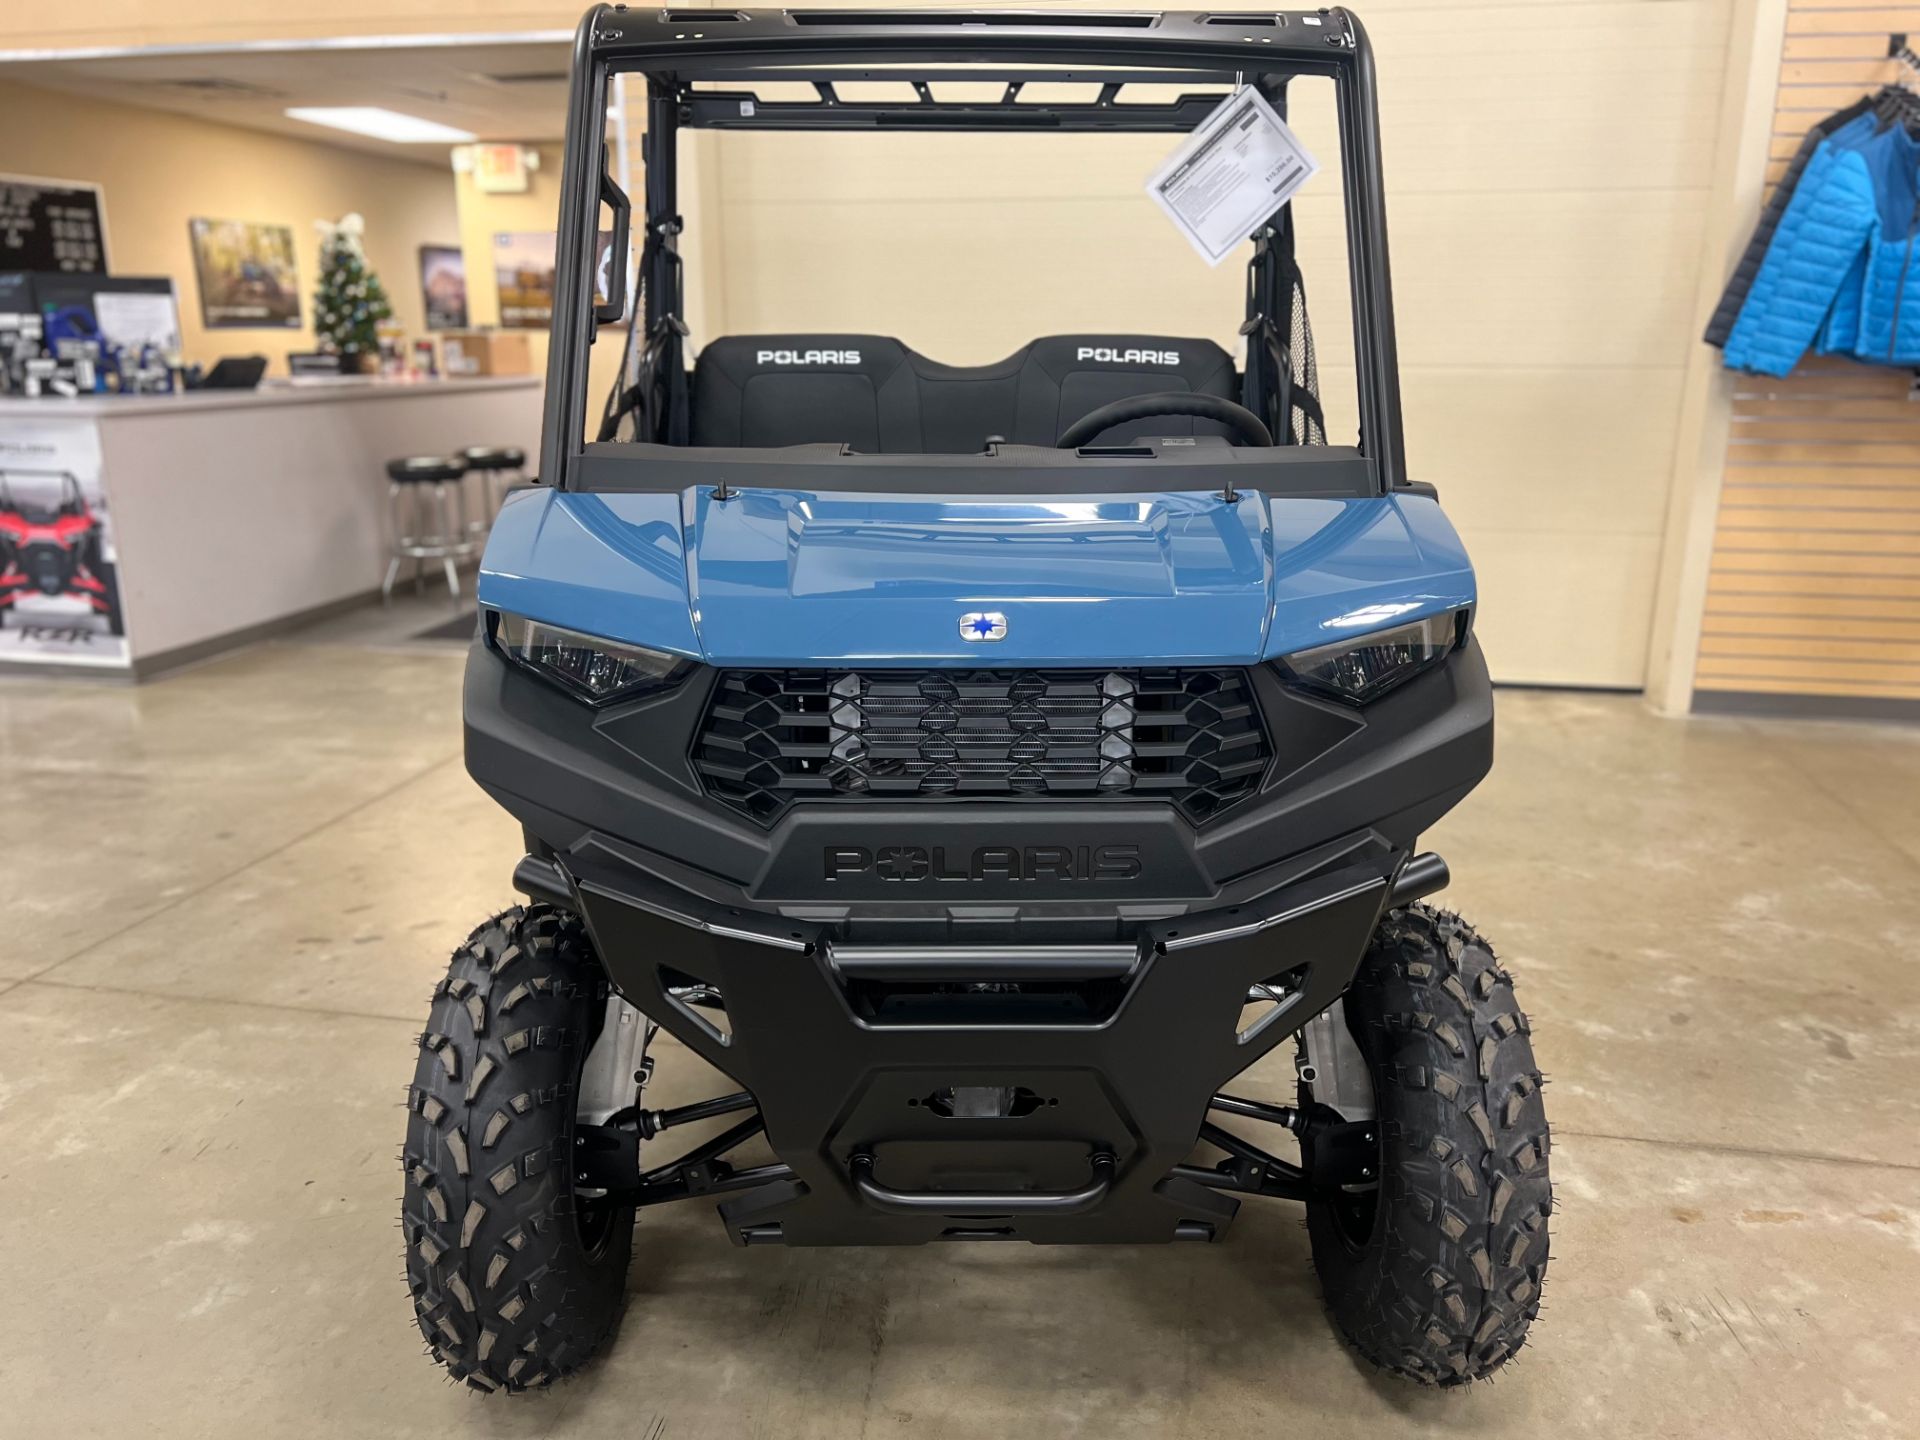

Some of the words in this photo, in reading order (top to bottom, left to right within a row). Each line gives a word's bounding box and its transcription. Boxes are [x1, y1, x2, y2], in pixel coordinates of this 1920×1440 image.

[757, 350, 861, 364] POLARIS
[1077, 347, 1180, 365] POLARIS
[824, 845, 1142, 881] POLARIS
